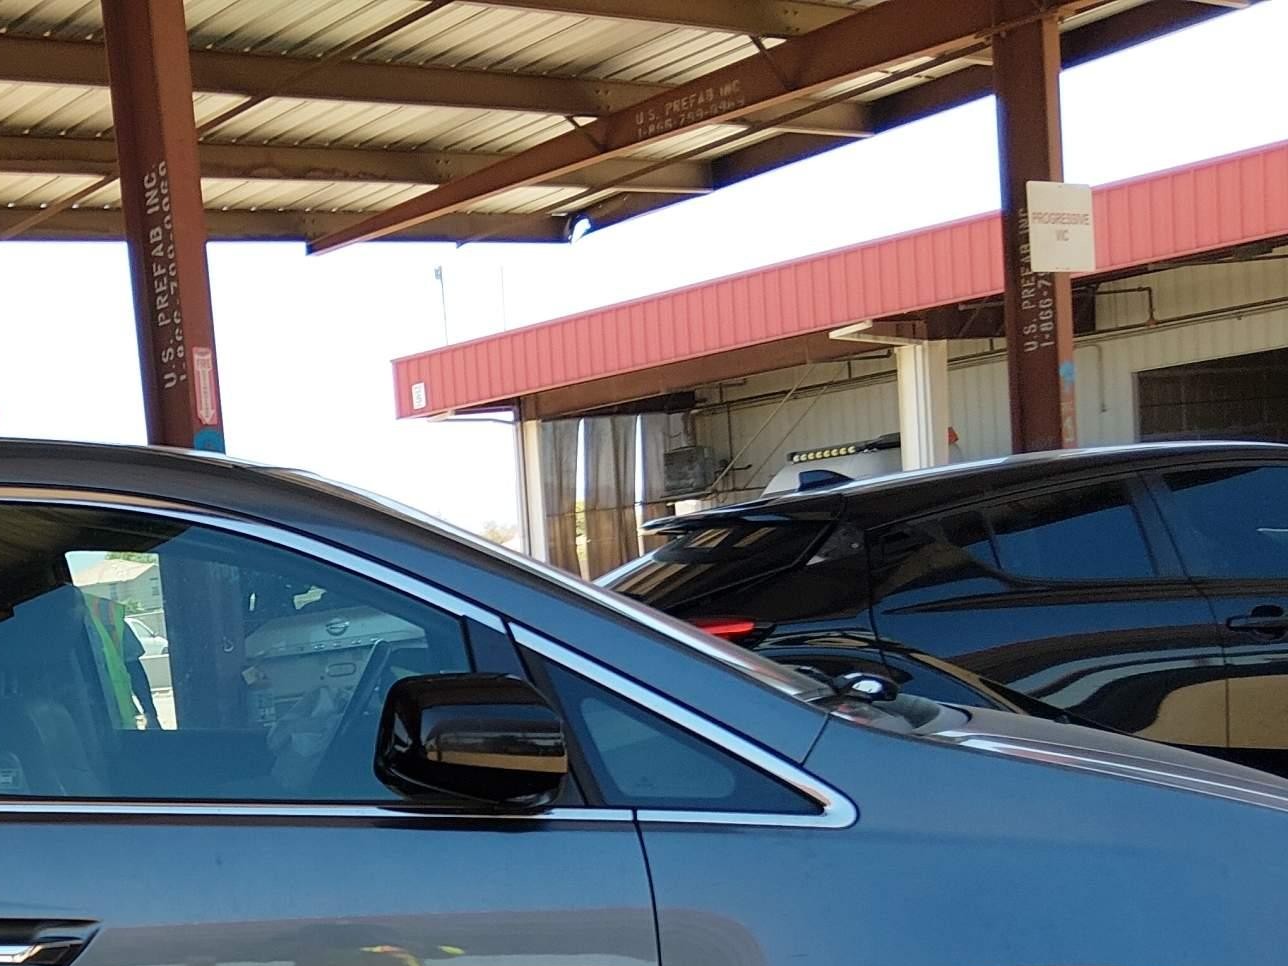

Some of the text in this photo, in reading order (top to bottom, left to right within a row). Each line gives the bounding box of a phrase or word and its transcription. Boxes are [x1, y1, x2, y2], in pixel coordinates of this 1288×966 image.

[665, 87, 714, 116] PREFAB
[1031, 211, 1091, 226] PROGRESSIVE
[149, 226, 172, 327] PREFAB
[1022, 318, 1039, 353] U.S.
[162, 338, 178, 389] U.S.
